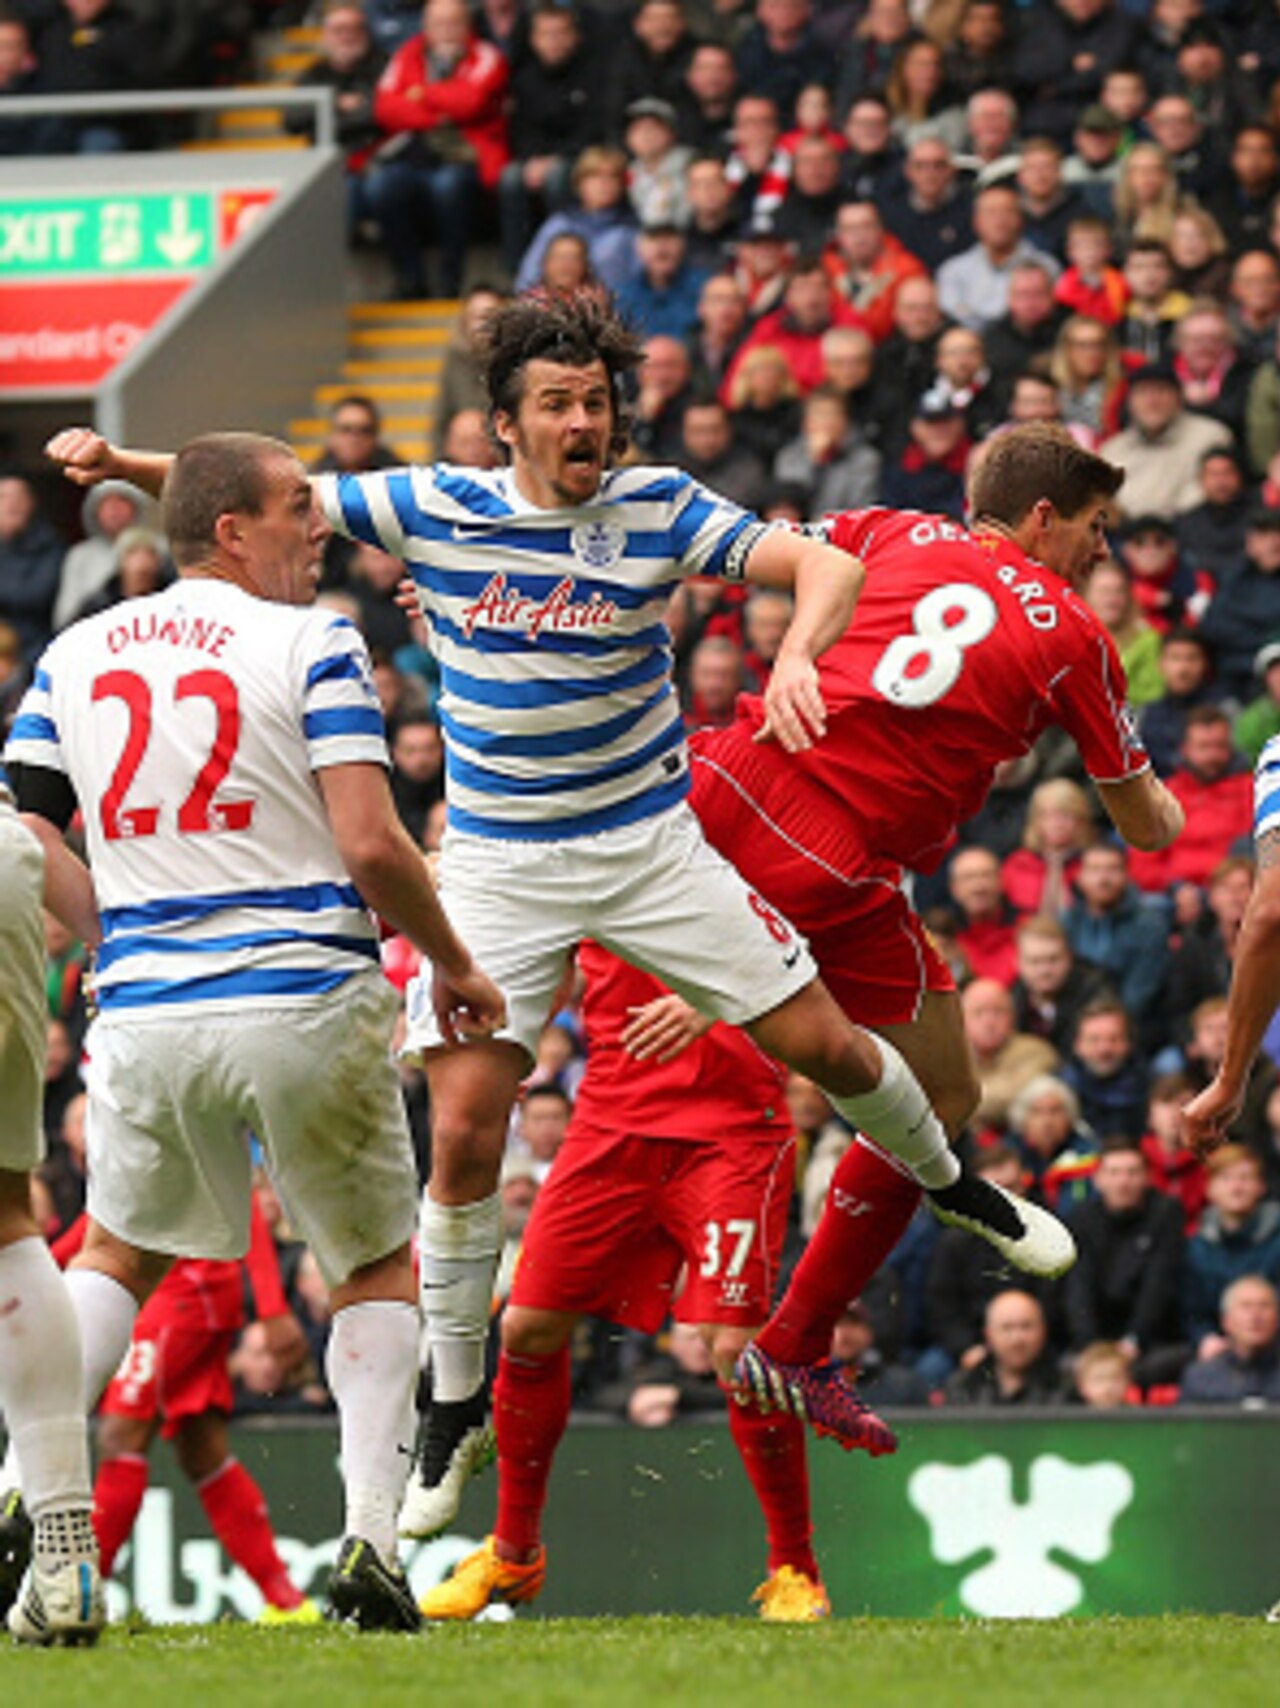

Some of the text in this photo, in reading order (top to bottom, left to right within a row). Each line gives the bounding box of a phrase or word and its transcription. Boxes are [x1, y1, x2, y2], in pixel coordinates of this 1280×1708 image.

[461, 570, 617, 640] AirAsia
[908, 520, 1059, 631] GEARD
[106, 613, 236, 658] DUNNE
[872, 582, 998, 710] 8
[91, 668, 257, 840] 22
[746, 890, 793, 945] 8
[700, 1219, 757, 1278] 37
